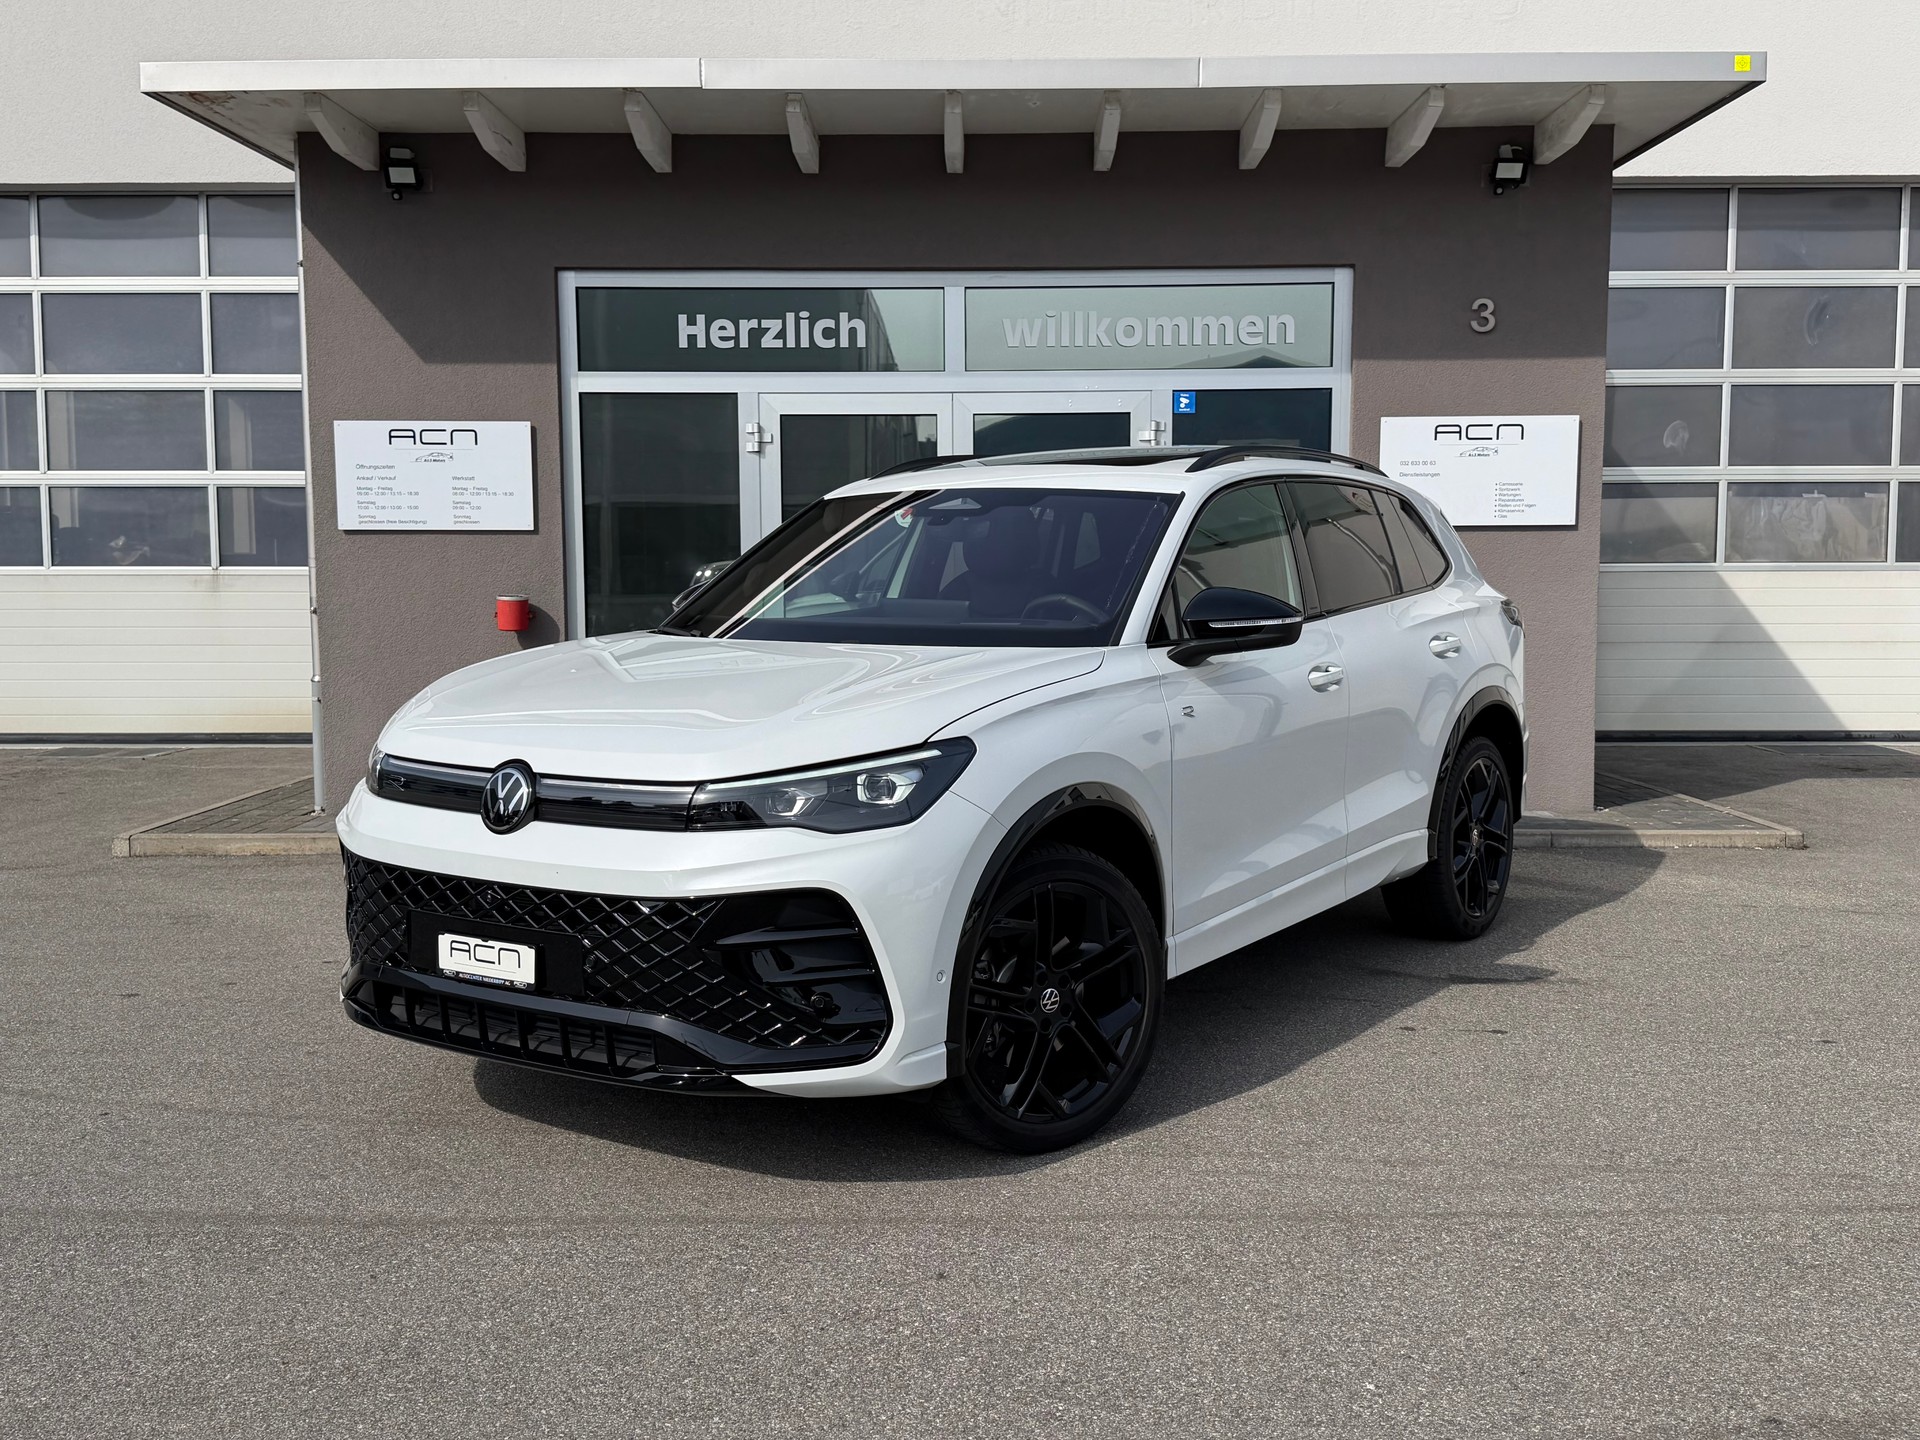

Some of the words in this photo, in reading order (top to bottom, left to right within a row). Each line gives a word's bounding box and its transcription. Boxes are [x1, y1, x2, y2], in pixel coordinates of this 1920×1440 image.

[1470, 297, 1496, 333] 3
[677, 311, 867, 348] Herzlich
[1001, 311, 1295, 348] willkommen
[388, 428, 478, 445] ACN
[1433, 424, 1524, 441] ACN
[355, 462, 396, 471] Öffnungszeiten
[449, 940, 521, 969] ACN
